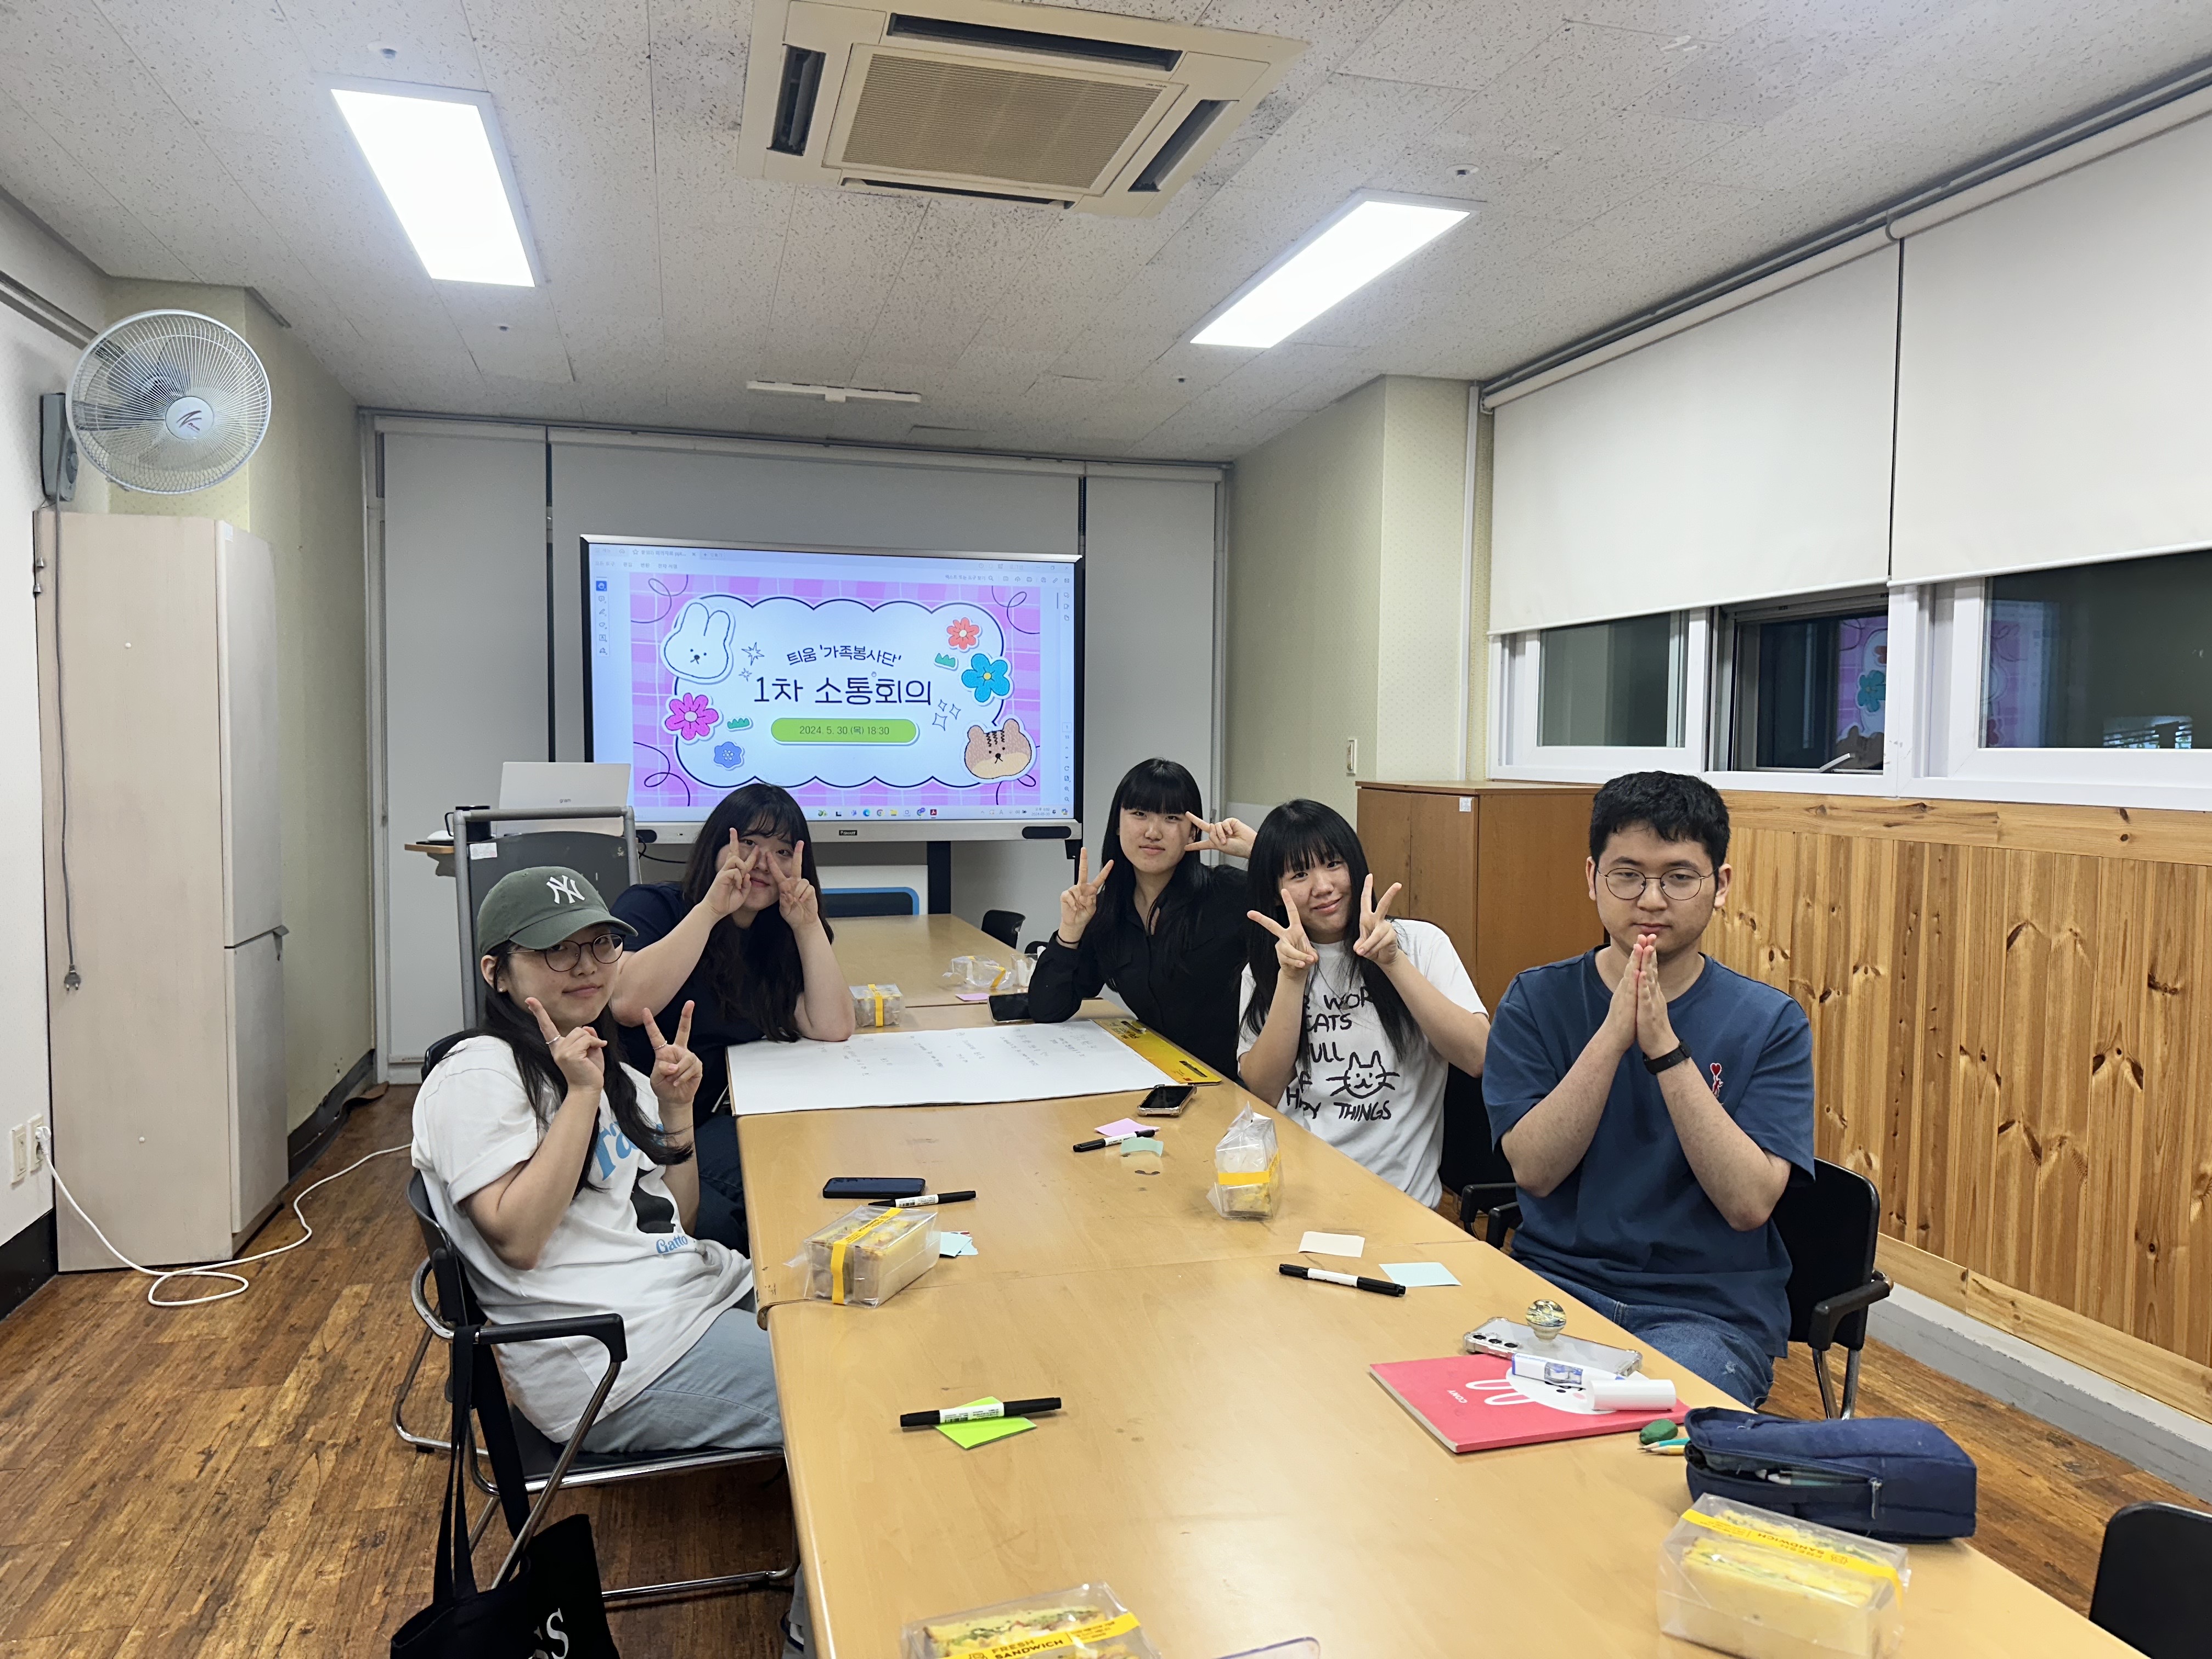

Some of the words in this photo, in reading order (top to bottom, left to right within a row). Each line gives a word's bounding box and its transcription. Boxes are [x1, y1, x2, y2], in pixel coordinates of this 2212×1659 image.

[786, 647, 817, 665] 틔움
[754, 676, 803, 702] 1차
[815, 677, 932, 706] 소통회의
[1310, 1041, 1345, 1063] ULL
[1333, 1100, 1392, 1122] THINGS
[1447, 1390, 1468, 1403] CONY
[1757, 1533, 1825, 1555] SANDWICH
[991, 1639, 1035, 1654] FRESH
[994, 1639, 1064, 1659] SANDWICH
